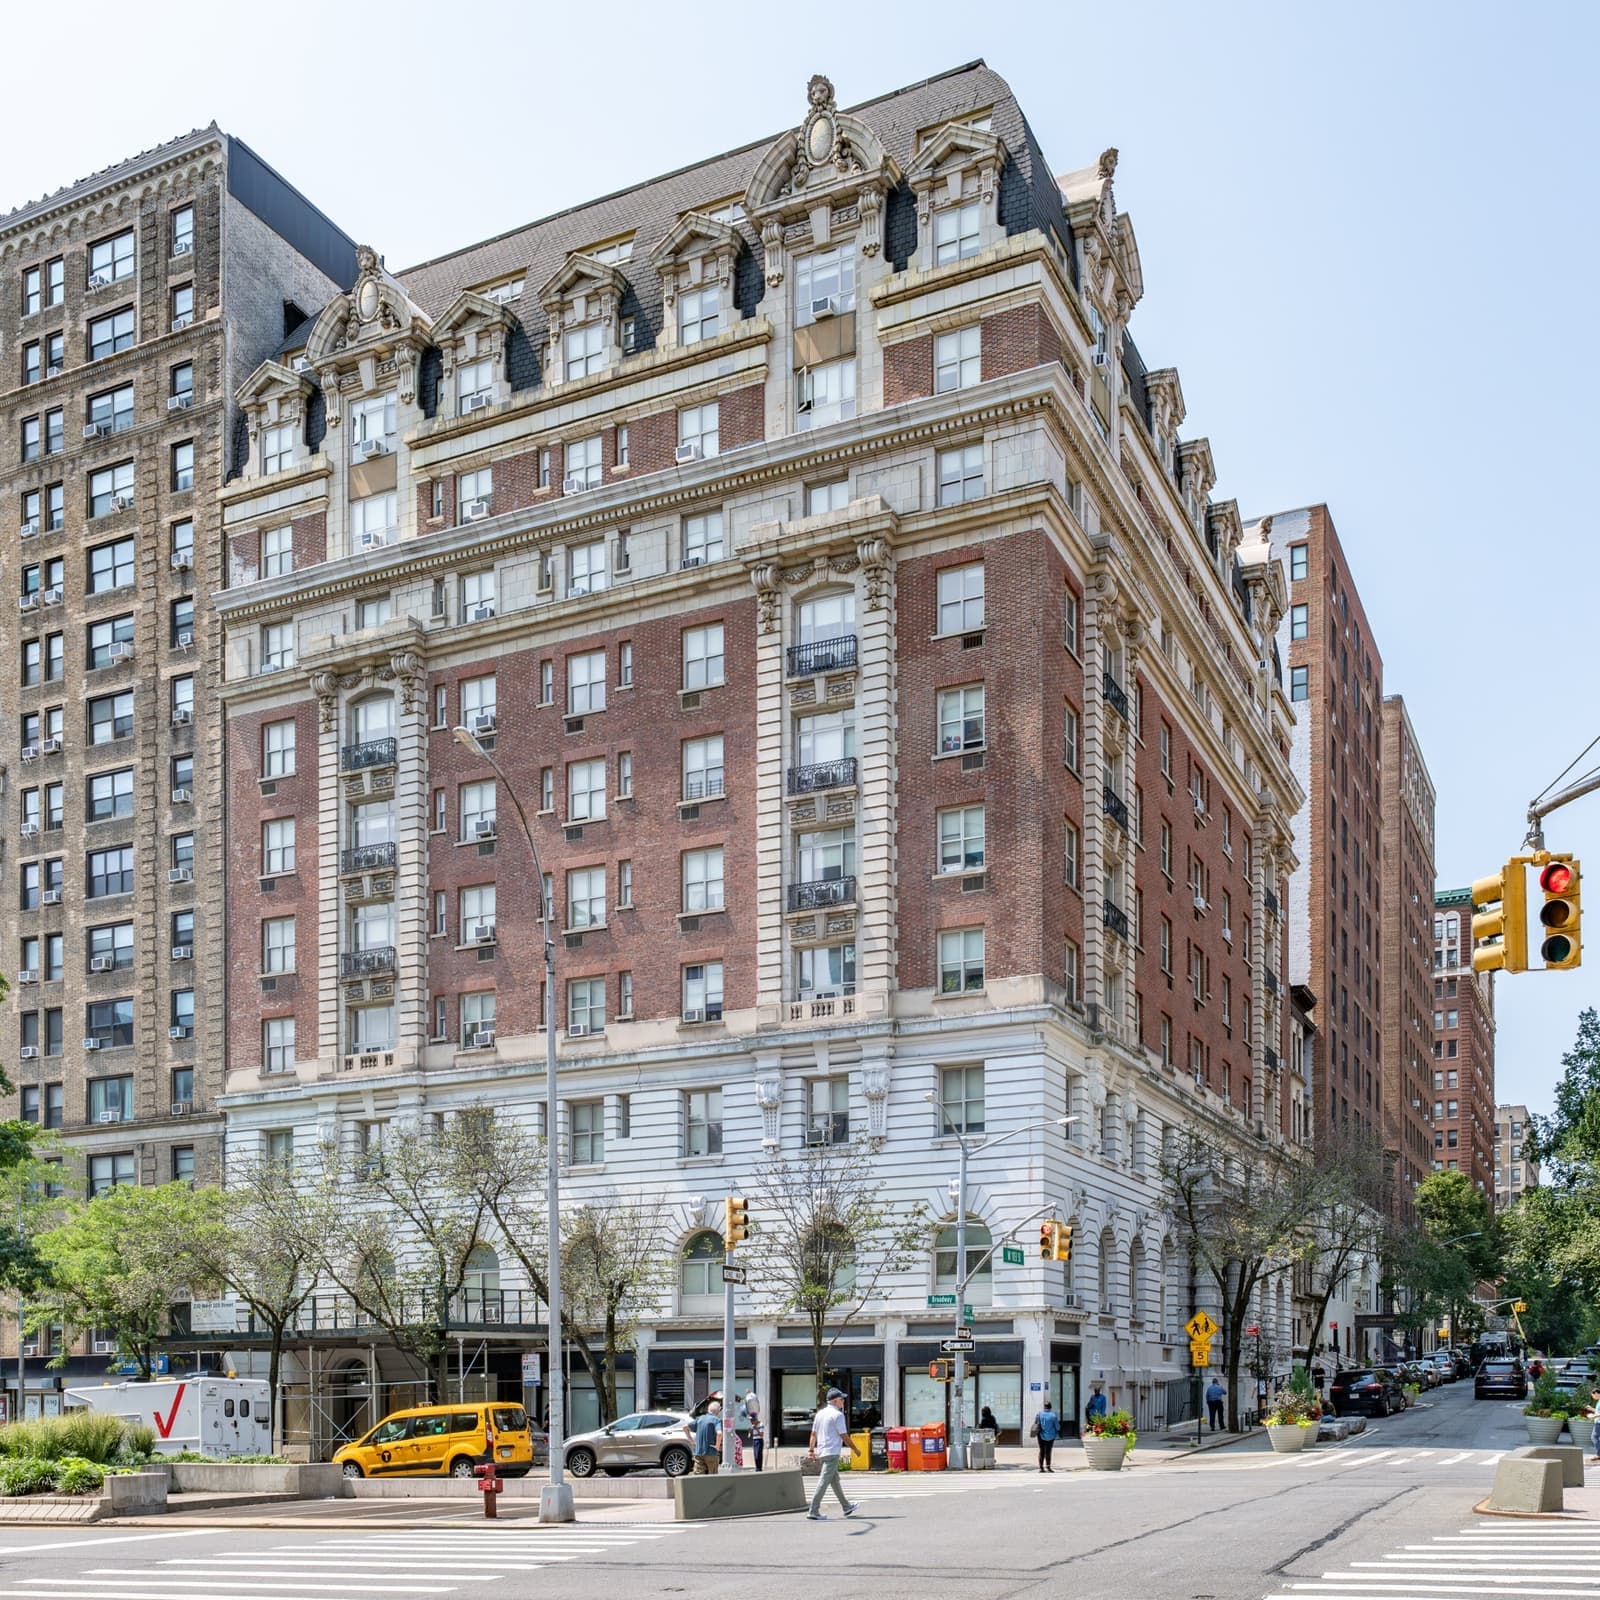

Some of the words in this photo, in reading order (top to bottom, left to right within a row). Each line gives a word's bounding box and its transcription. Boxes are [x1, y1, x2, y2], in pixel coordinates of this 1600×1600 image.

[725, 1270, 734, 1278] ONE
[931, 1296, 953, 1304] Broadway
[1197, 1351, 1204, 1360] 5
[383, 1452, 390, 1462] T
